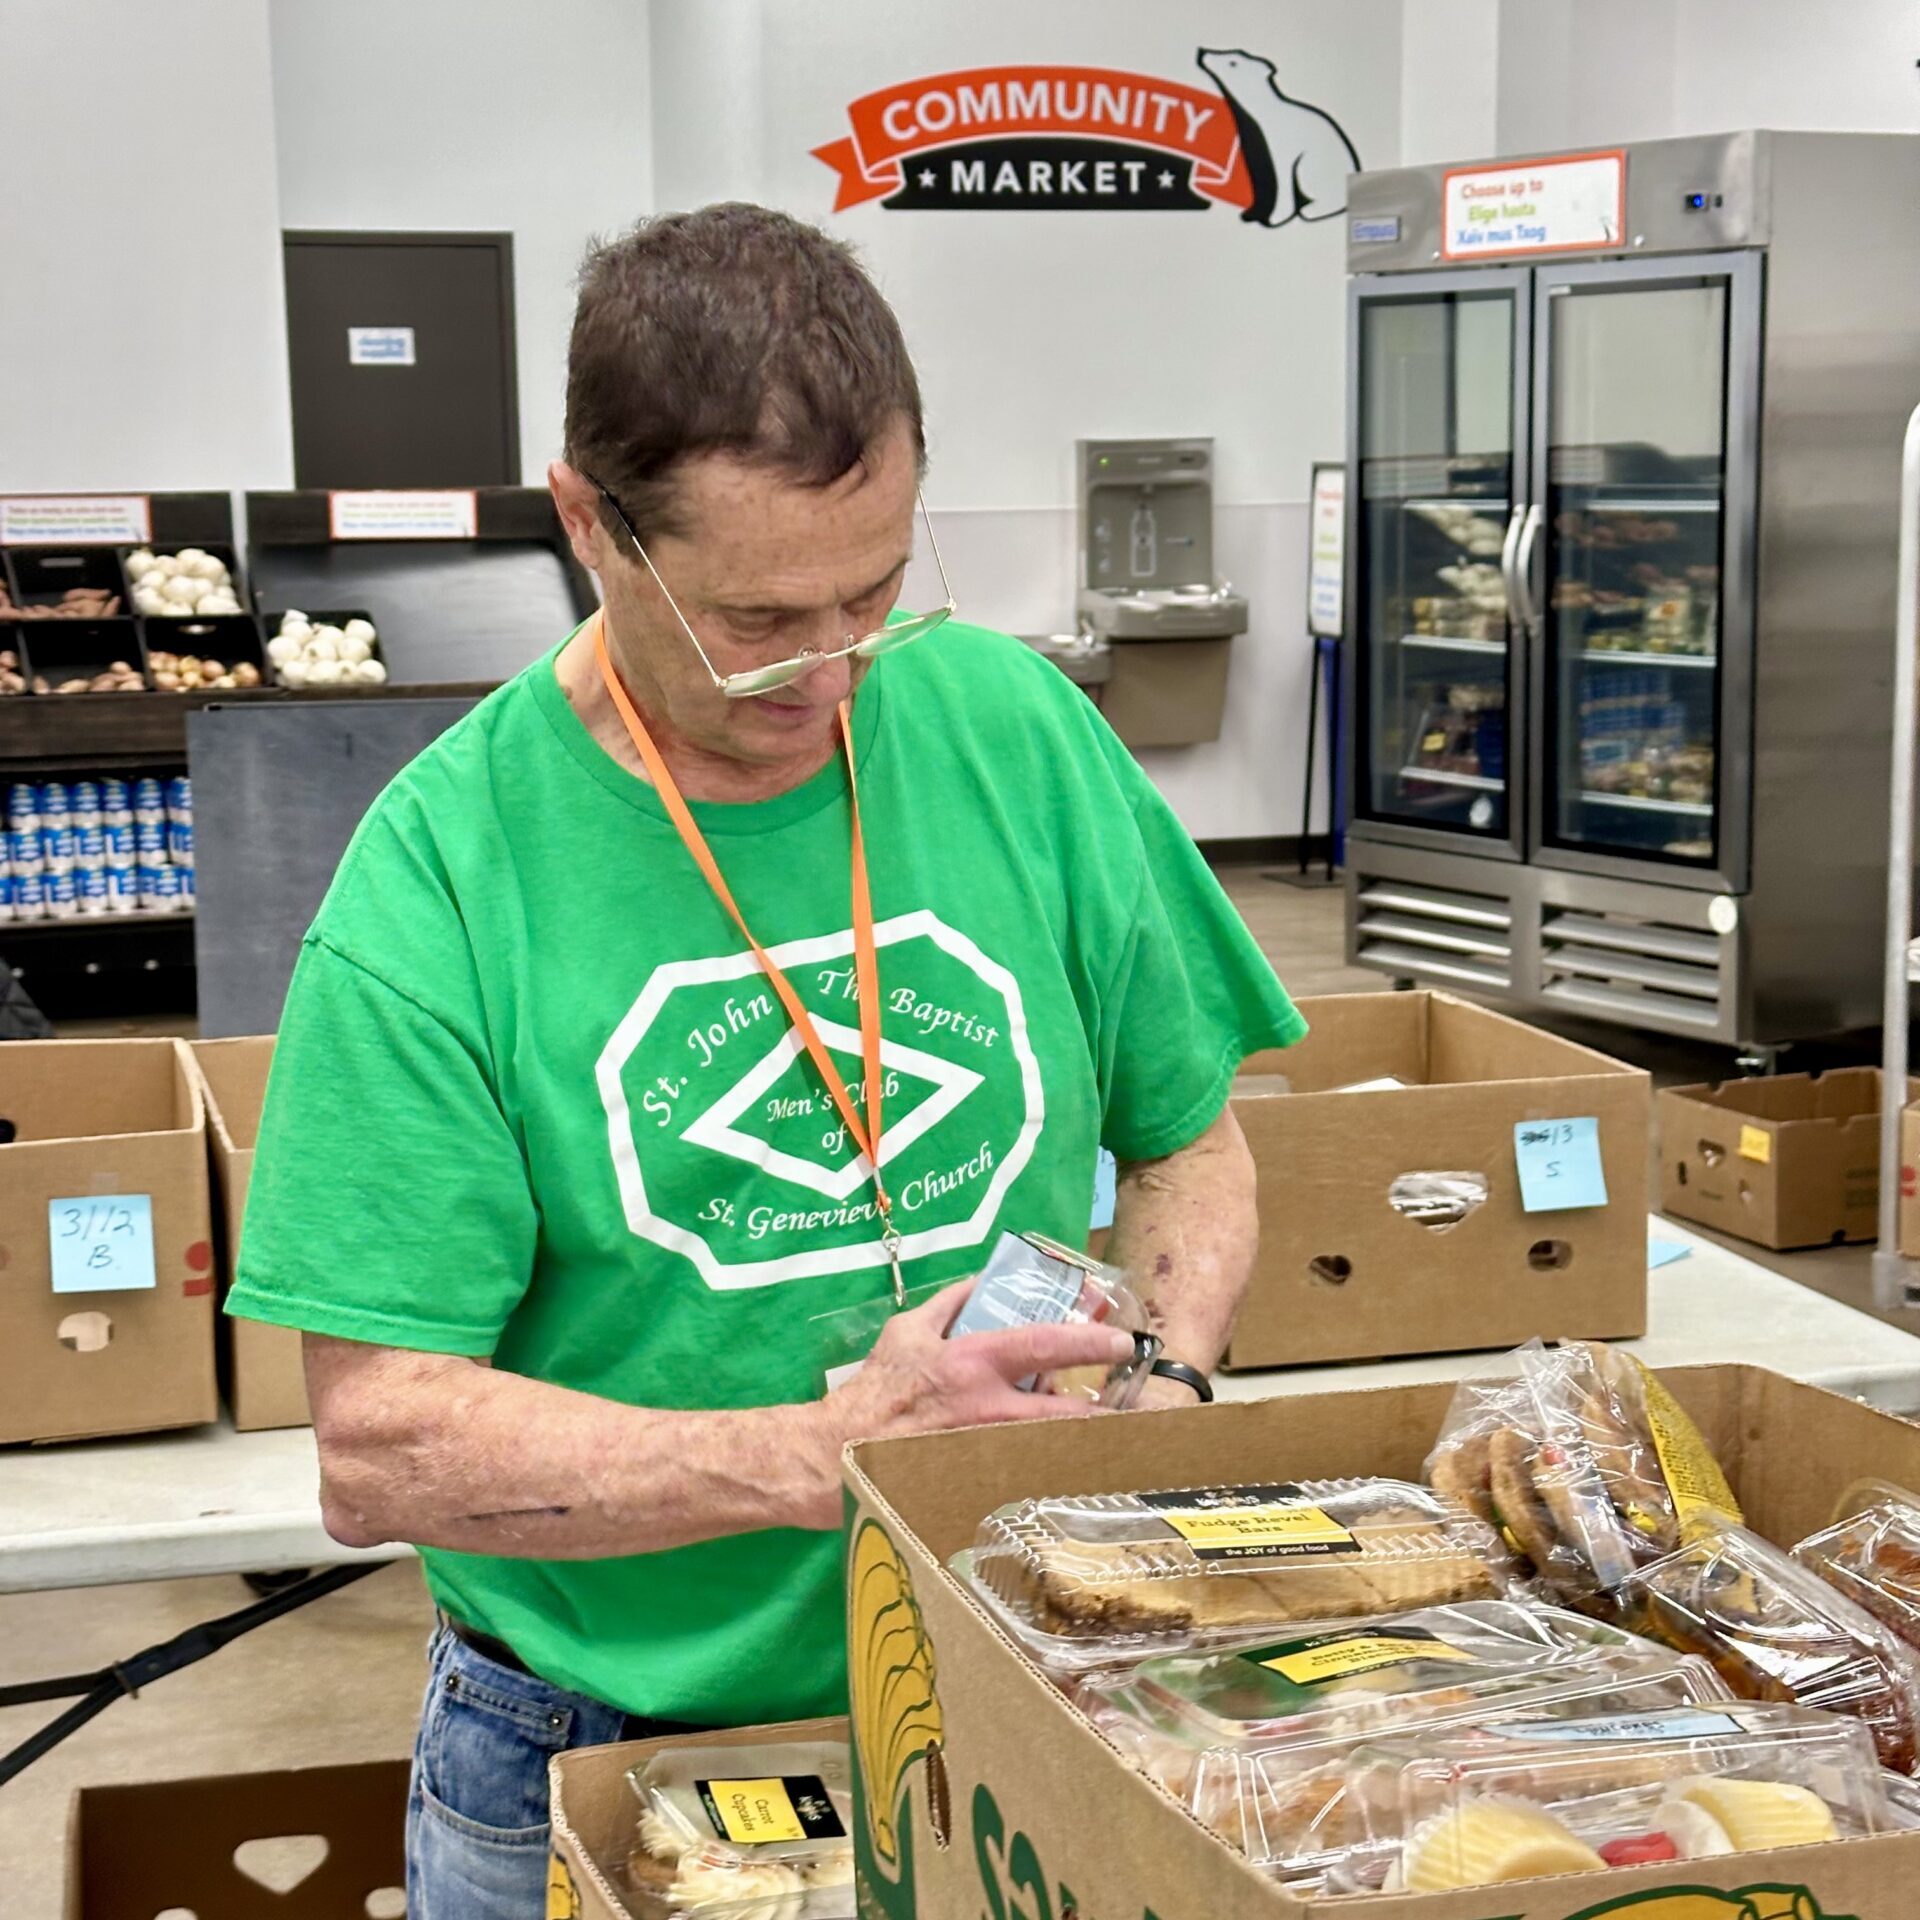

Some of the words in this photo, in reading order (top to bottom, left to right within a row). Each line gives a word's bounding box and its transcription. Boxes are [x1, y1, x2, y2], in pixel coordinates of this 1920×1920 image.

[882, 80, 1213, 141] COMMUNITY
[950, 160, 1146, 193] MARKET
[1510, 181, 1526, 195] up
[1530, 179, 1544, 192] to
[642, 1075, 688, 1128] St.
[687, 992, 774, 1067] John
[817, 967, 859, 1001] Th
[888, 987, 1000, 1049] Baptist
[766, 1088, 833, 1121] Men's
[844, 1071, 900, 1108] Clb
[821, 1120, 848, 1155] of
[697, 1198, 735, 1227] St.
[747, 1200, 885, 1240] Geneviev
[900, 1141, 994, 1214] Church
[86, 1244, 114, 1269] B
[1186, 1518, 1249, 1529] Fudge
[1253, 1512, 1313, 1525] Revel
[1236, 1525, 1283, 1535] Bars
[1244, 1546, 1265, 1555] JOY
[1268, 1546, 1277, 1554] of
[732, 1792, 756, 1833] Cupcakes
[754, 1798, 775, 1825] Carrot
